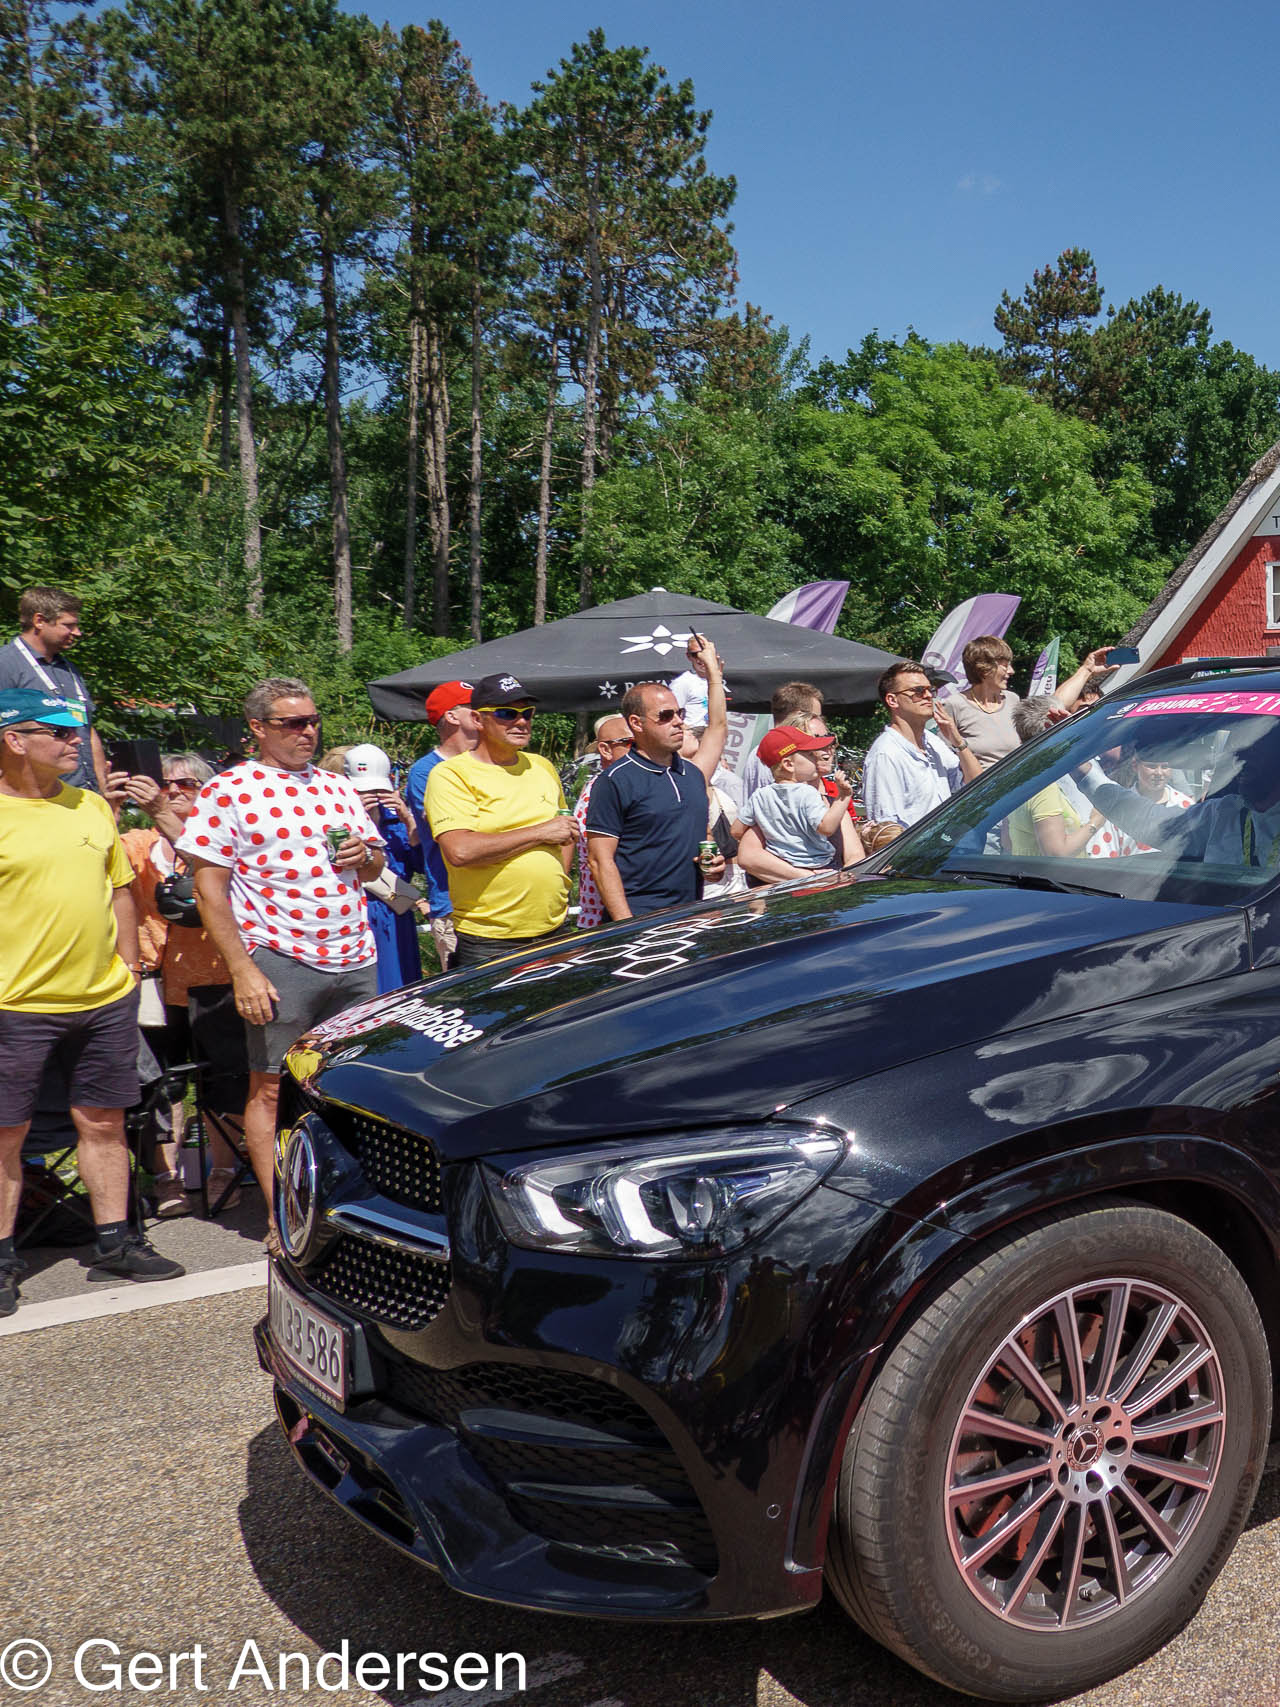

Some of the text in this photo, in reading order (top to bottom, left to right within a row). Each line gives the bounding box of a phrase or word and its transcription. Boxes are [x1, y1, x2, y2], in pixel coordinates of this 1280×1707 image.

[1136, 699, 1209, 713] CARAVANE
[376, 998, 485, 1048] PentaBase
[286, 1299, 303, 1355] 33
[307, 1316, 341, 1383] 586
